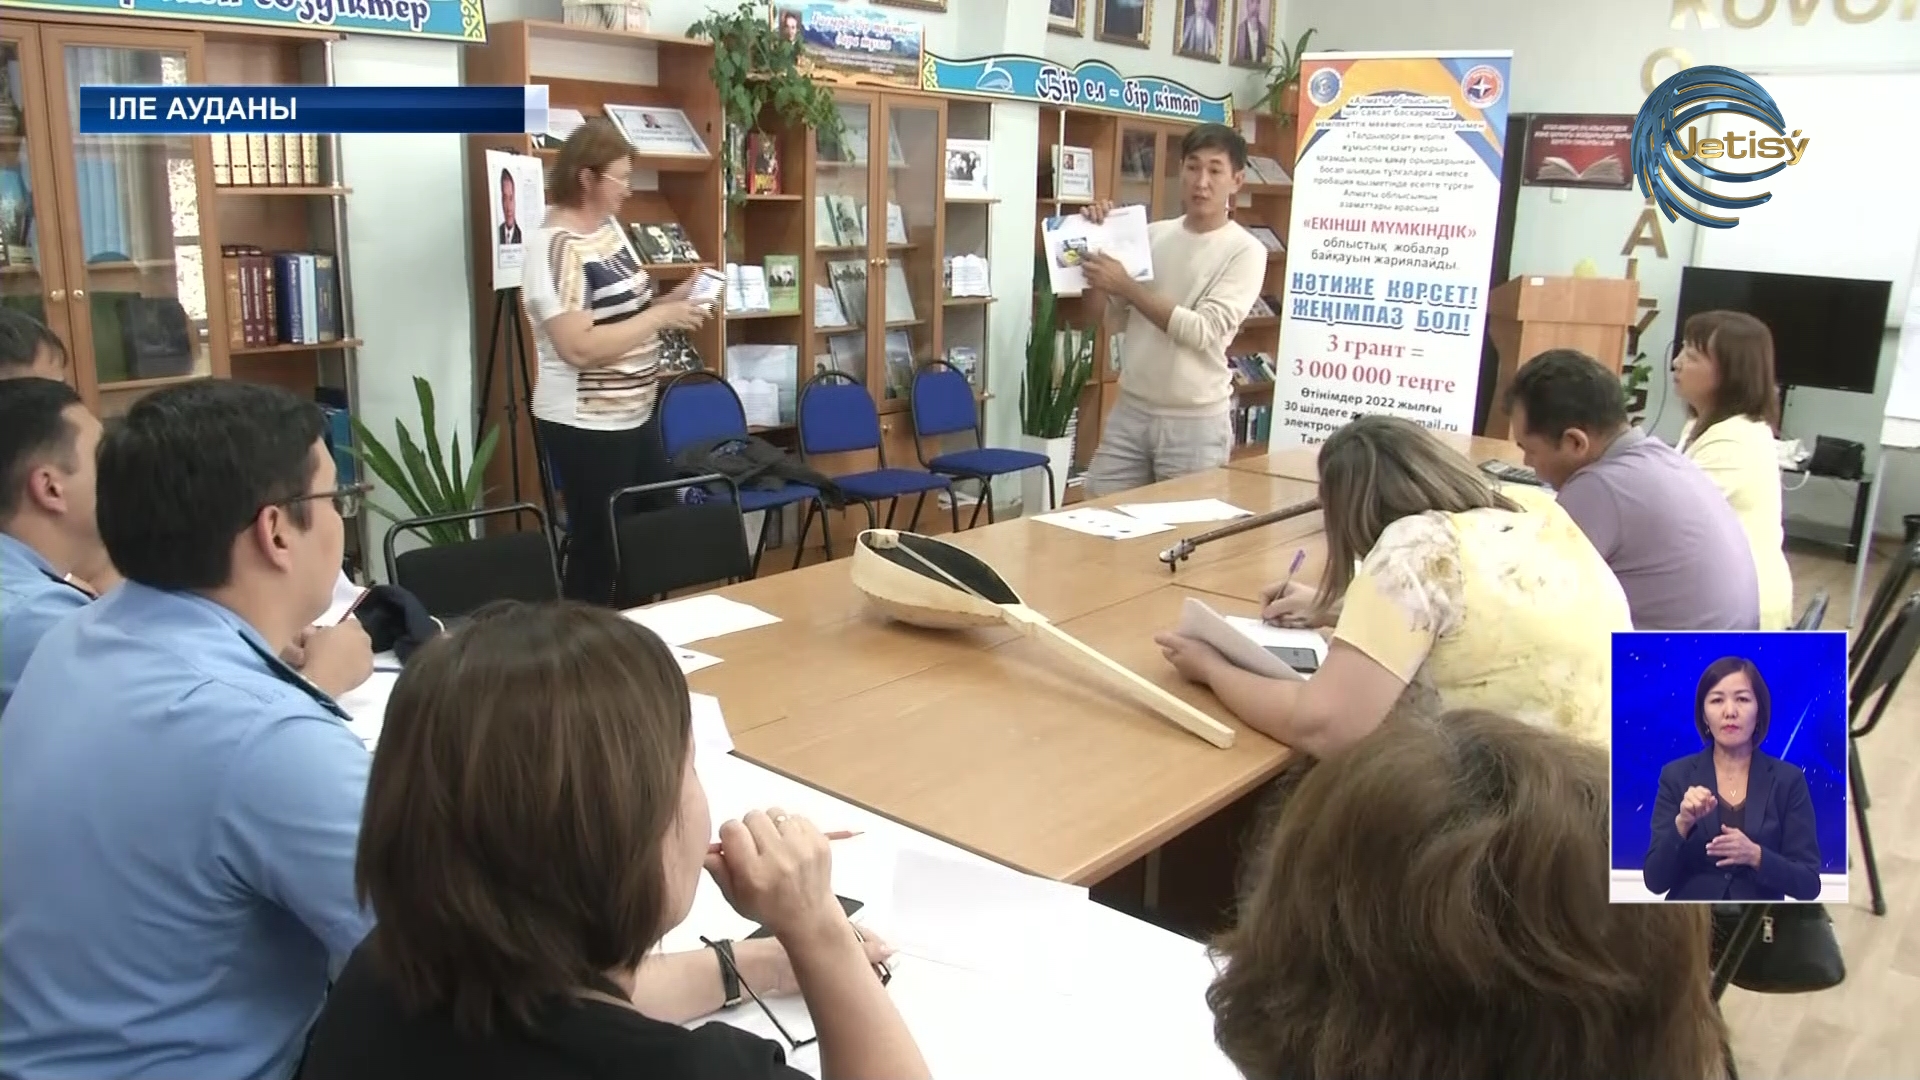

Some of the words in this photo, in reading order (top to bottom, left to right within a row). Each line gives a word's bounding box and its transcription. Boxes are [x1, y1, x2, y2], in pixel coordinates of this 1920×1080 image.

[1037, 67, 1079, 104] Бір
[1086, 79, 1105, 101] ел
[1123, 80, 1148, 112] бір
[1154, 86, 1200, 115] кітап
[1304, 217, 1366, 232] «ЕКІНШІ
[1371, 220, 1477, 239] МҮМКІНДІК»
[1311, 249, 1370, 264] байқауын
[1323, 237, 1387, 252] облыстық
[1393, 243, 1449, 256] жобалар
[1292, 272, 1375, 297] НӘТИЖЕ
[1387, 279, 1477, 305] КӨРСЕТ!
[1292, 297, 1404, 326] ЖЕҢІМПАЗ
[1416, 310, 1471, 332] БОЛ!
[1327, 334, 1338, 352] 3
[1344, 339, 1406, 360] грант
[1292, 358, 1304, 377] 3
[1309, 360, 1347, 380] 000
[1352, 365, 1391, 386] 000
[1396, 373, 1456, 396] теңге
[1285, 401, 1298, 412] 30
[1300, 404, 1349, 418] шілдеге
[1301, 387, 1363, 406] Өтінімдер
[1365, 395, 1395, 408] 2022
[1398, 399, 1442, 414] жылғы
